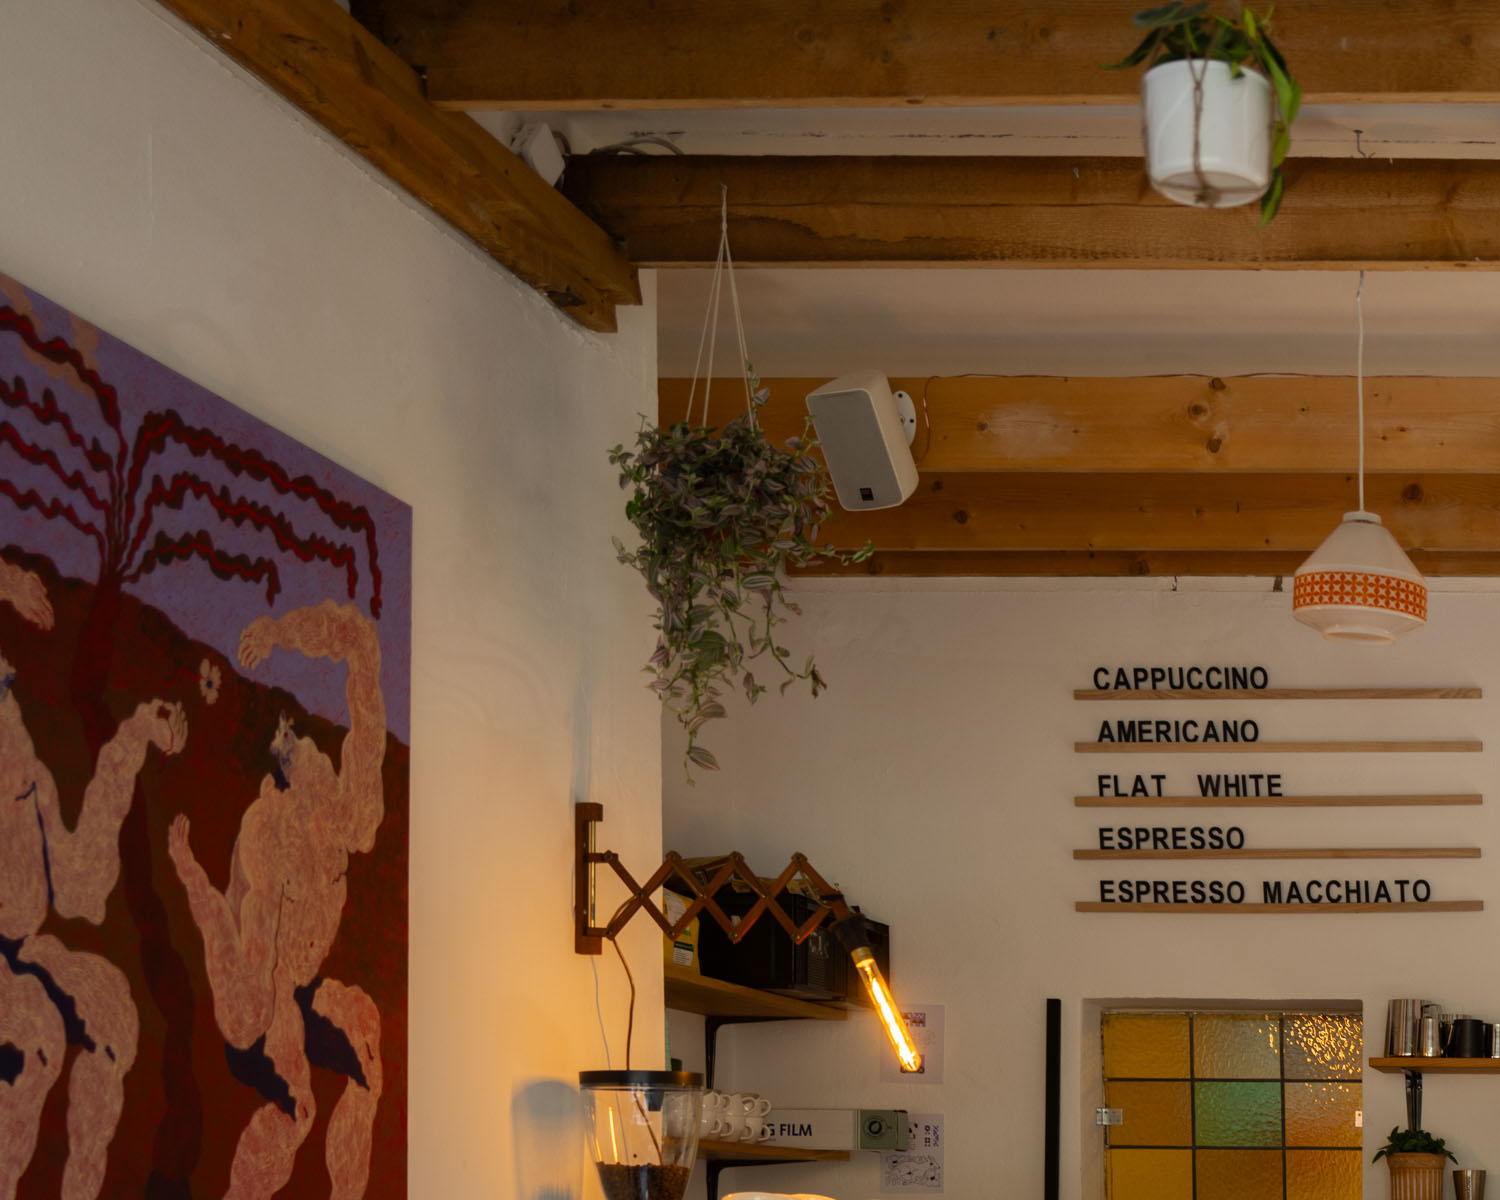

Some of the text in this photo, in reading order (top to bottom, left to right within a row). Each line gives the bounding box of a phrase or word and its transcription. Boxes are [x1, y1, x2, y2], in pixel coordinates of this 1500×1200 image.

[1093, 666, 1269, 690] CAPPUCCINO
[1098, 719, 1259, 742] AMERICANO
[1098, 774, 1283, 797] FLAT WHITE
[1099, 826, 1245, 850] ESPRESSO
[1100, 879, 1431, 904] ESPRESSO MACCHIATO
[780, 1123, 813, 1136] FILM
